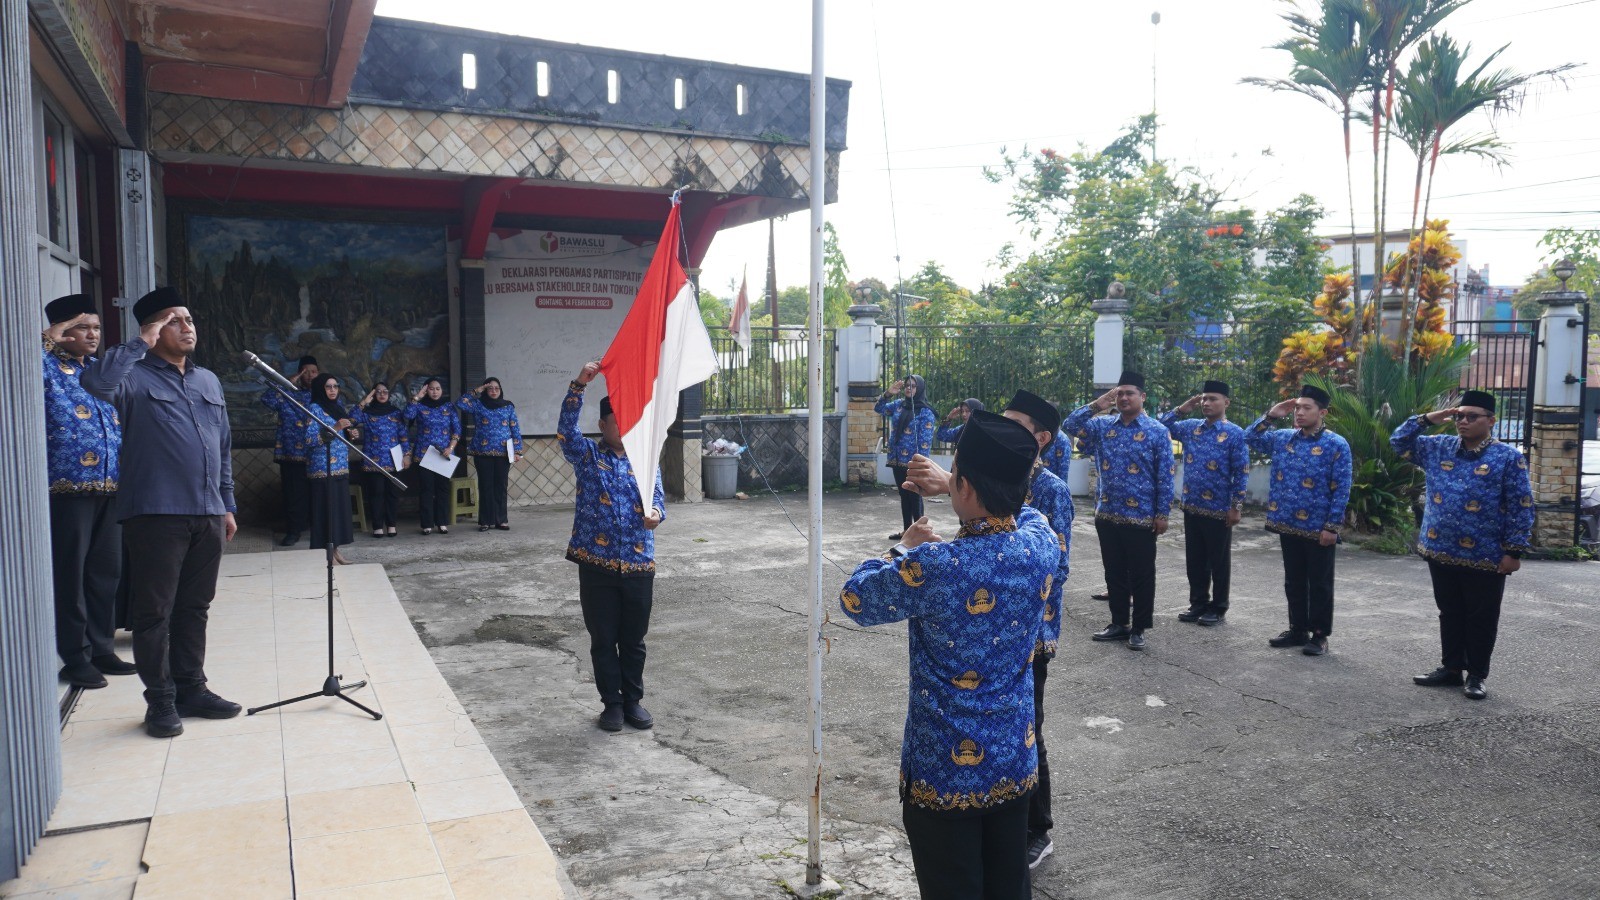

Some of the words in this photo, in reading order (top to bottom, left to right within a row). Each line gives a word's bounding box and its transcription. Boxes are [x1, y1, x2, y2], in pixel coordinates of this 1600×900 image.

[560, 236, 605, 247] BAWASLU
[502, 266, 548, 278] DEKLARASI
[549, 266, 592, 278] PENGAWAS
[593, 268, 642, 282] PARTISIPATIF
[495, 281, 535, 294] BERSAMA
[536, 281, 591, 293] STAKEHOLDER
[592, 283, 608, 294] DAN
[610, 284, 634, 295] TOKOH
[597, 299, 610, 307] 2023
